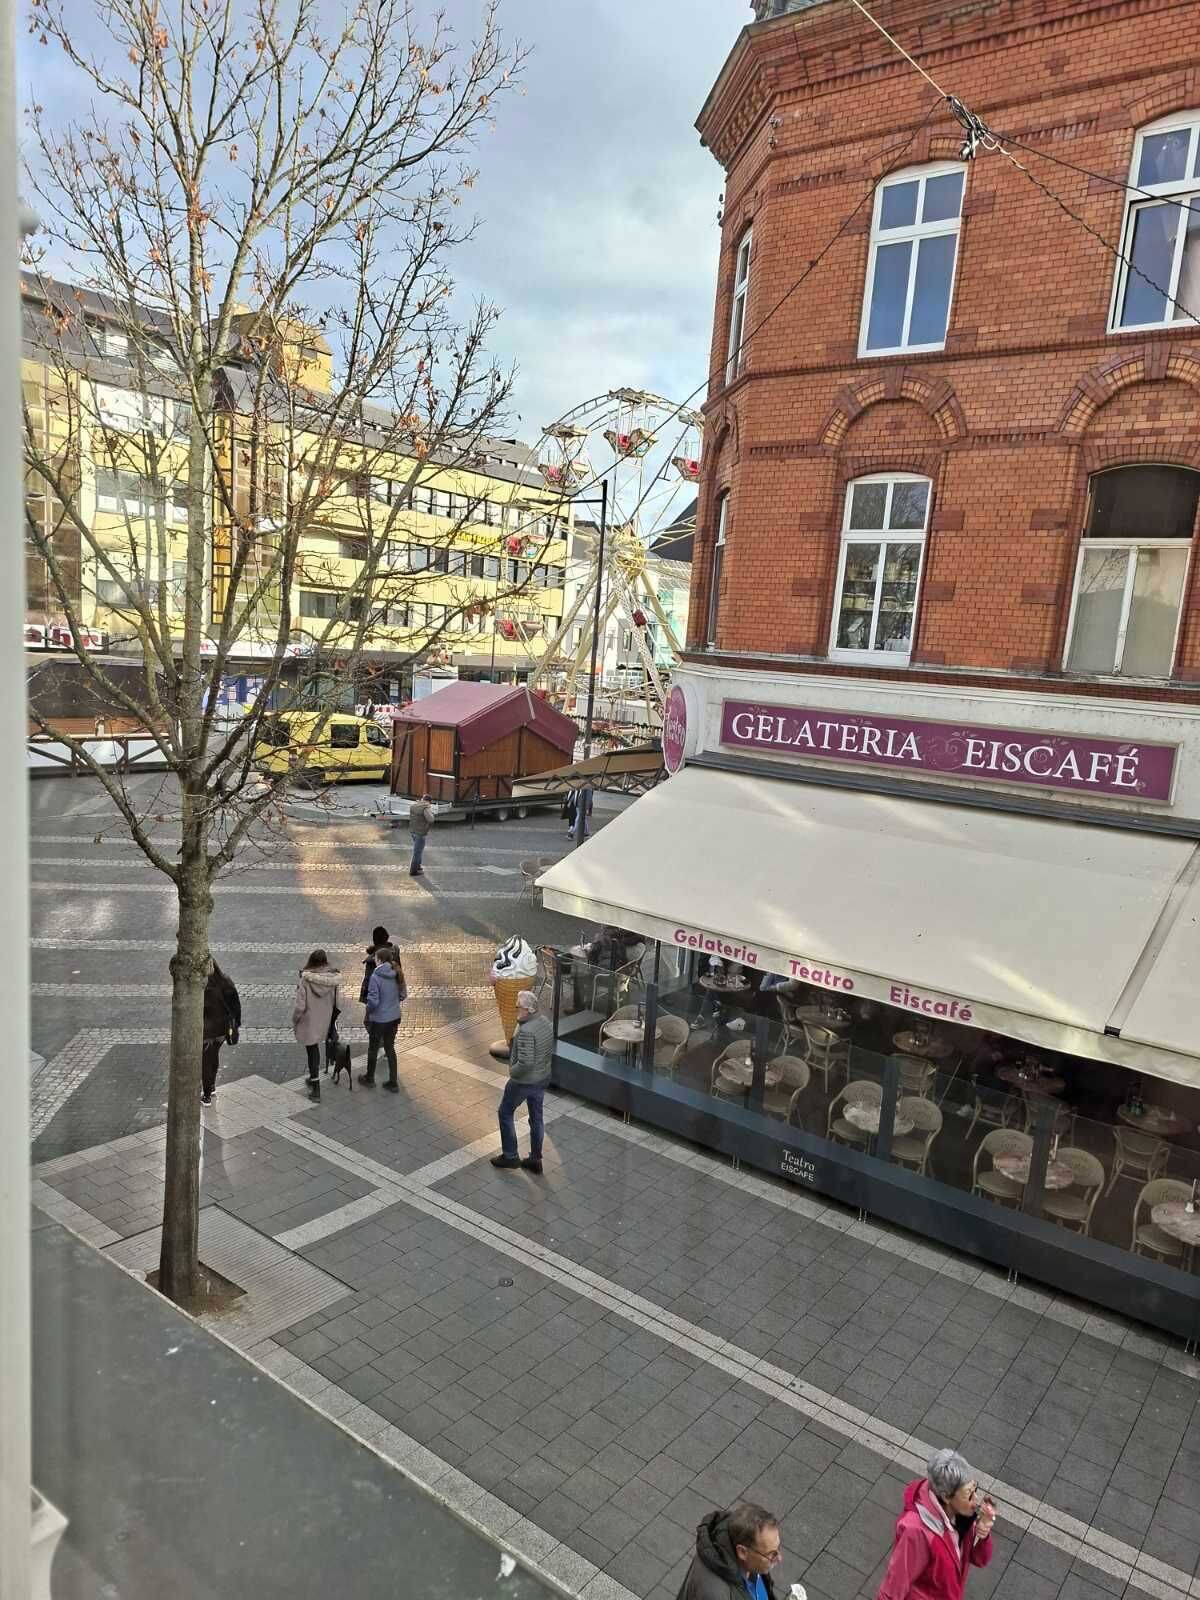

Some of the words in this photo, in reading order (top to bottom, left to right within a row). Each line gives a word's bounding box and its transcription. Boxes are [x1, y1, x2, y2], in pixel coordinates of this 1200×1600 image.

[732, 712, 922, 761] GELATERIA
[962, 738, 1140, 788] EISCAFÉ
[673, 928, 758, 966] Gelateria
[788, 959, 855, 991] Teatro
[889, 985, 973, 1022] Eiscafé
[782, 1149, 816, 1171] Teatro
